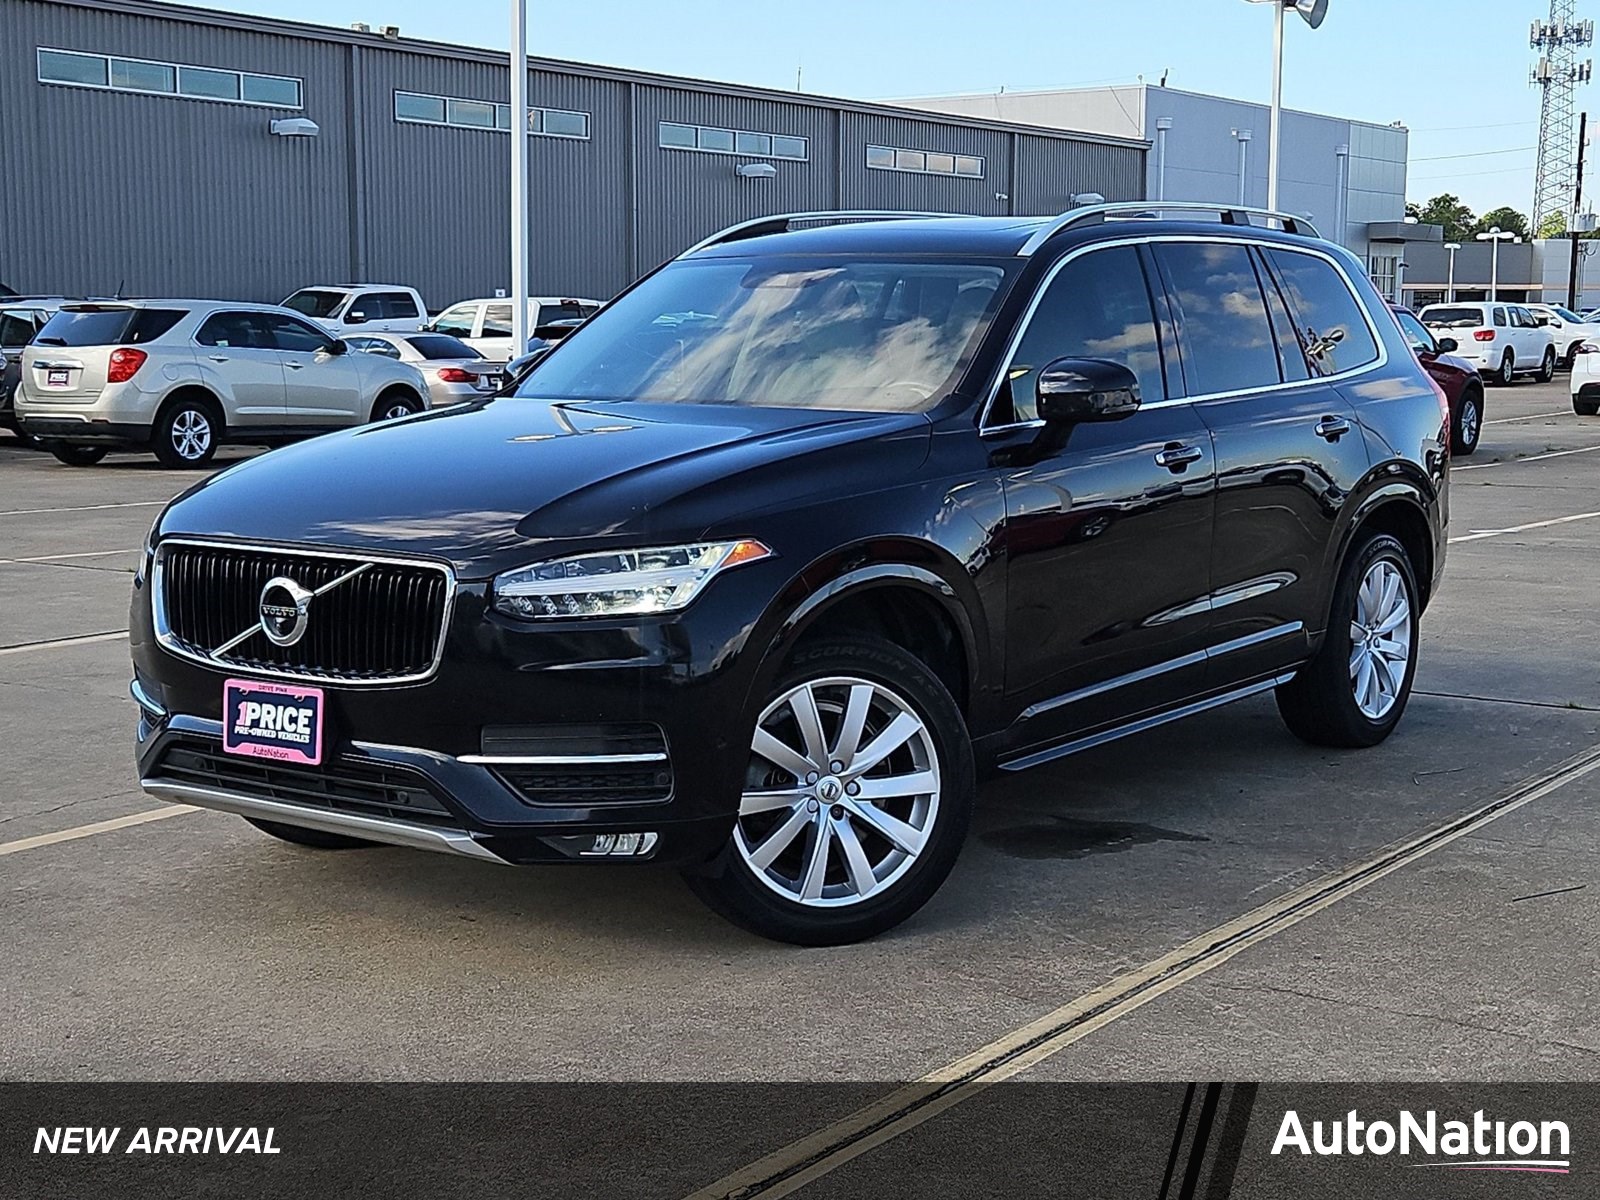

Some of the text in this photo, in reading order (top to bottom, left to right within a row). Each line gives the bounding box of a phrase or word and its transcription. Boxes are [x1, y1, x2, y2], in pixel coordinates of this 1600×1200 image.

[263, 606, 295, 617] VOLVO
[792, 645, 907, 671] SCORPION
[258, 684, 274, 692] DRIVE
[234, 725, 310, 744] PRE-OWNED VEHICLES
[252, 746, 289, 759] AutoNation
